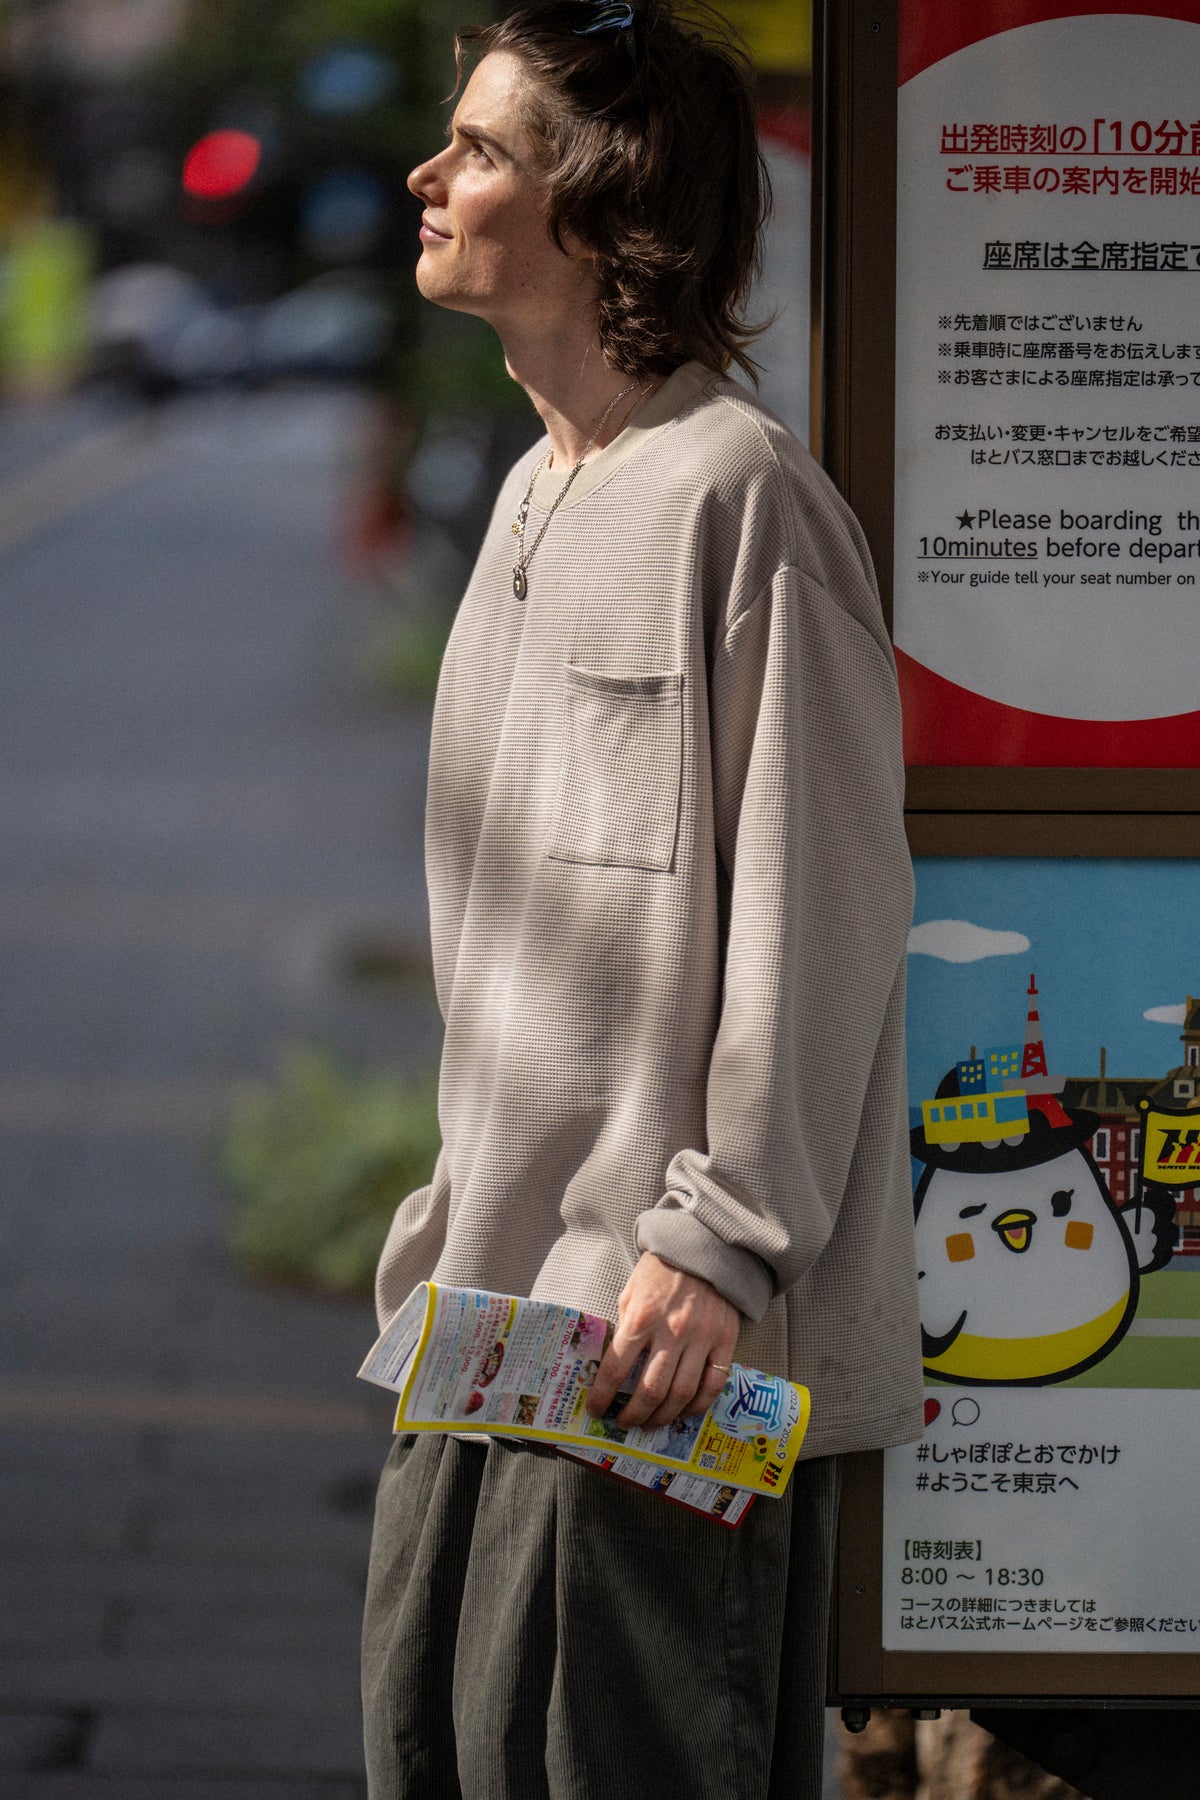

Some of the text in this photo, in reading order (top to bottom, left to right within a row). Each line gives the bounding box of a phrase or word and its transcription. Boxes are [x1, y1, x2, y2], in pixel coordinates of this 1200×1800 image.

[946, 164, 1200, 196] ご乗車の案内を開始
[1060, 509, 1162, 536] boarding
[918, 536, 1039, 559] 10minutes
[1046, 537, 1121, 558] before
[969, 570, 1011, 588] guide
[1014, 570, 1039, 585] tell
[1043, 574, 1076, 588] your
[1080, 573, 1112, 586] seat
[1115, 571, 1172, 586] number
[1176, 574, 1196, 586] on
[726, 1369, 783, 1431] 夏
[916, 1442, 1121, 1465] #しゃぽぽとおでかけ
[916, 1472, 1079, 1494] #ようこそ東京へ
[904, 1540, 983, 1561] 【時刻表】
[901, 1567, 948, 1585] 8:00
[985, 1568, 1044, 1586] 18:30
[901, 1598, 1096, 1613] コースの詳細につきましては
